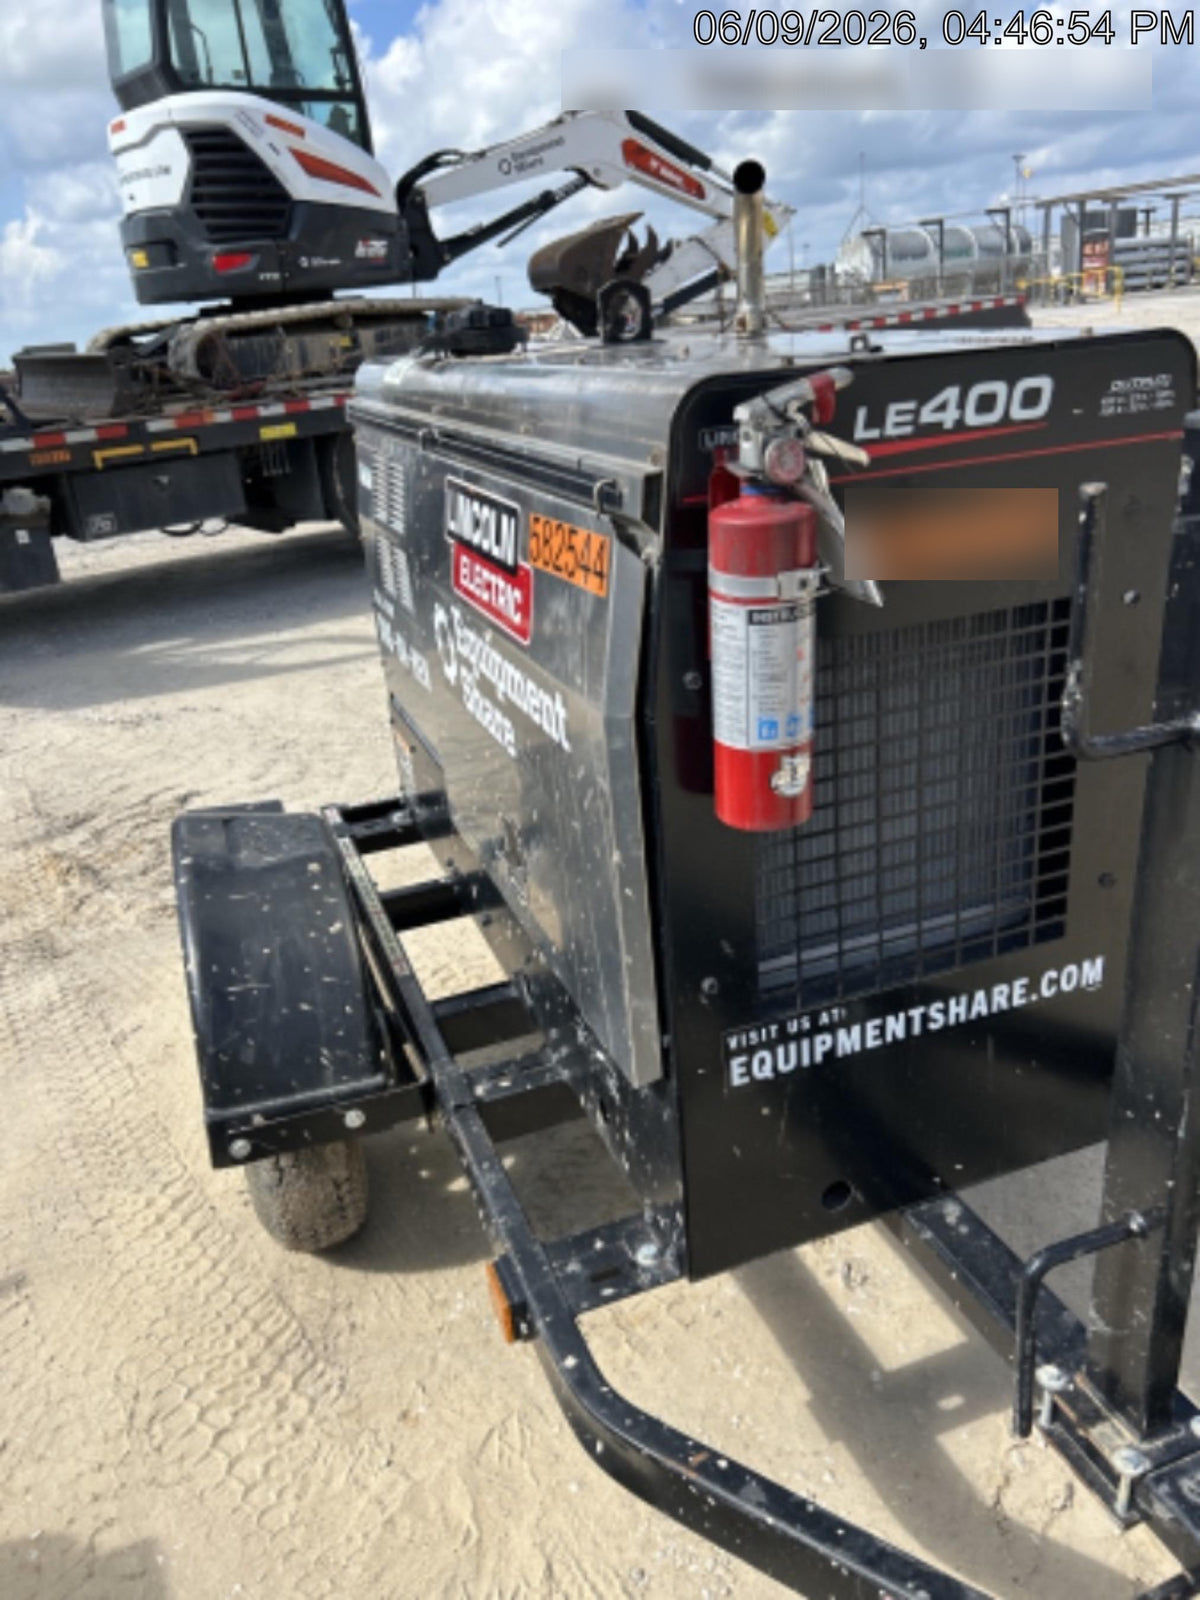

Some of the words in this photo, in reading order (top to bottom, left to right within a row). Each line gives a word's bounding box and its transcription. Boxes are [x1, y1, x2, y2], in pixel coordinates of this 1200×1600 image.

[852, 375, 1053, 440] LE400
[447, 486, 517, 567] LINCOLN
[529, 514, 607, 592] 582544
[458, 554, 523, 626] ELECTRIC
[454, 608, 572, 752] Equipment
[461, 668, 518, 757] Share
[726, 1024, 779, 1050] VISIT
[786, 1015, 811, 1035] US
[729, 956, 1105, 1087] EQUIPMENTSHARE.COM
